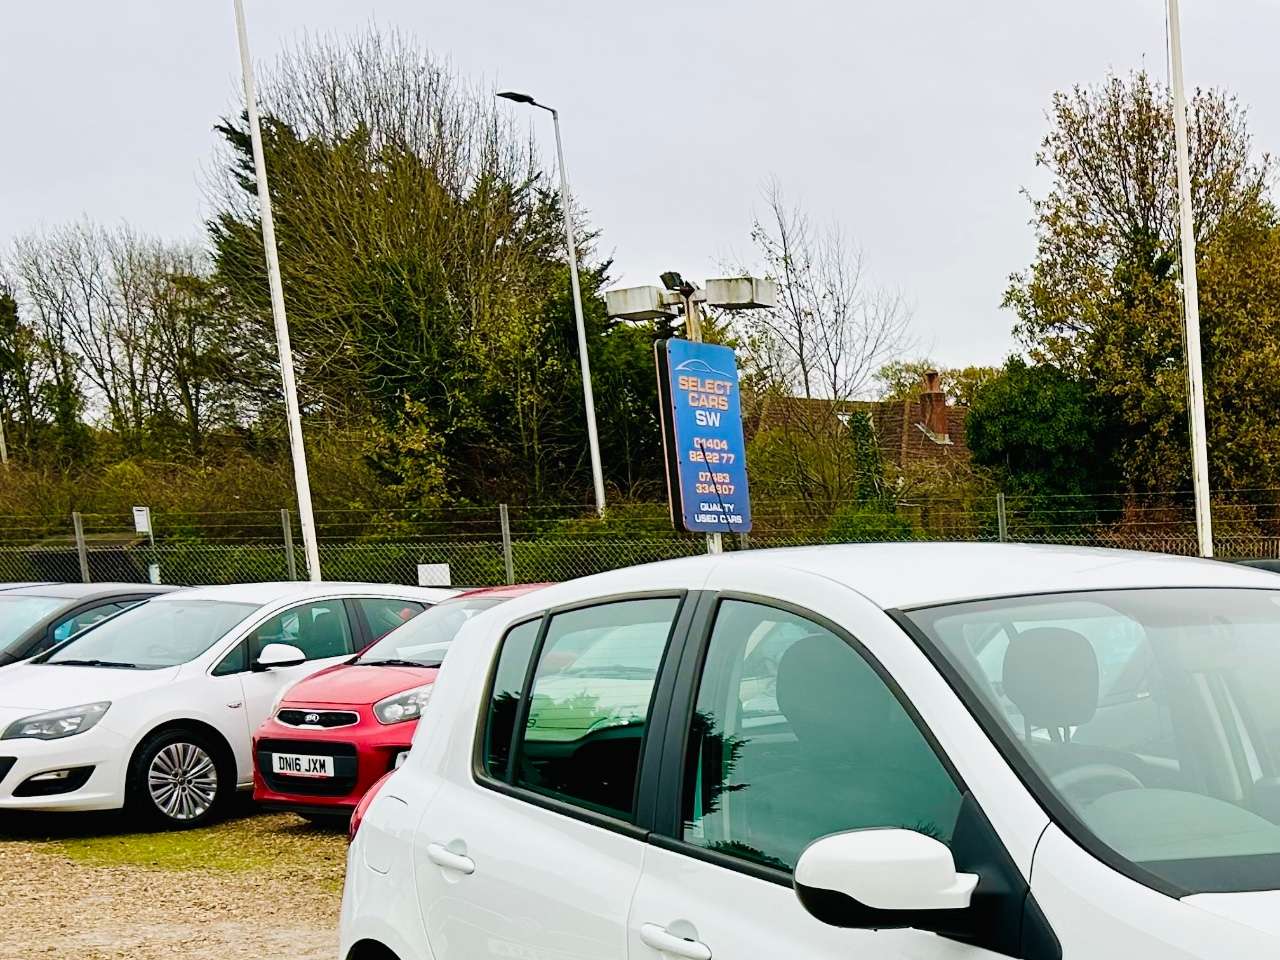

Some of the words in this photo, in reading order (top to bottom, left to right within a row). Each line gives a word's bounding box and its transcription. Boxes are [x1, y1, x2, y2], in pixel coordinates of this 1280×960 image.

[678, 375, 733, 395] SELECT
[688, 392, 729, 410] CARS
[695, 409, 721, 428] SW
[693, 437, 728, 450] 01404
[699, 502, 734, 512] QUALTY
[694, 513, 718, 523] USED
[278, 756, 302, 772] DN16
[304, 758, 327, 774] JXM
